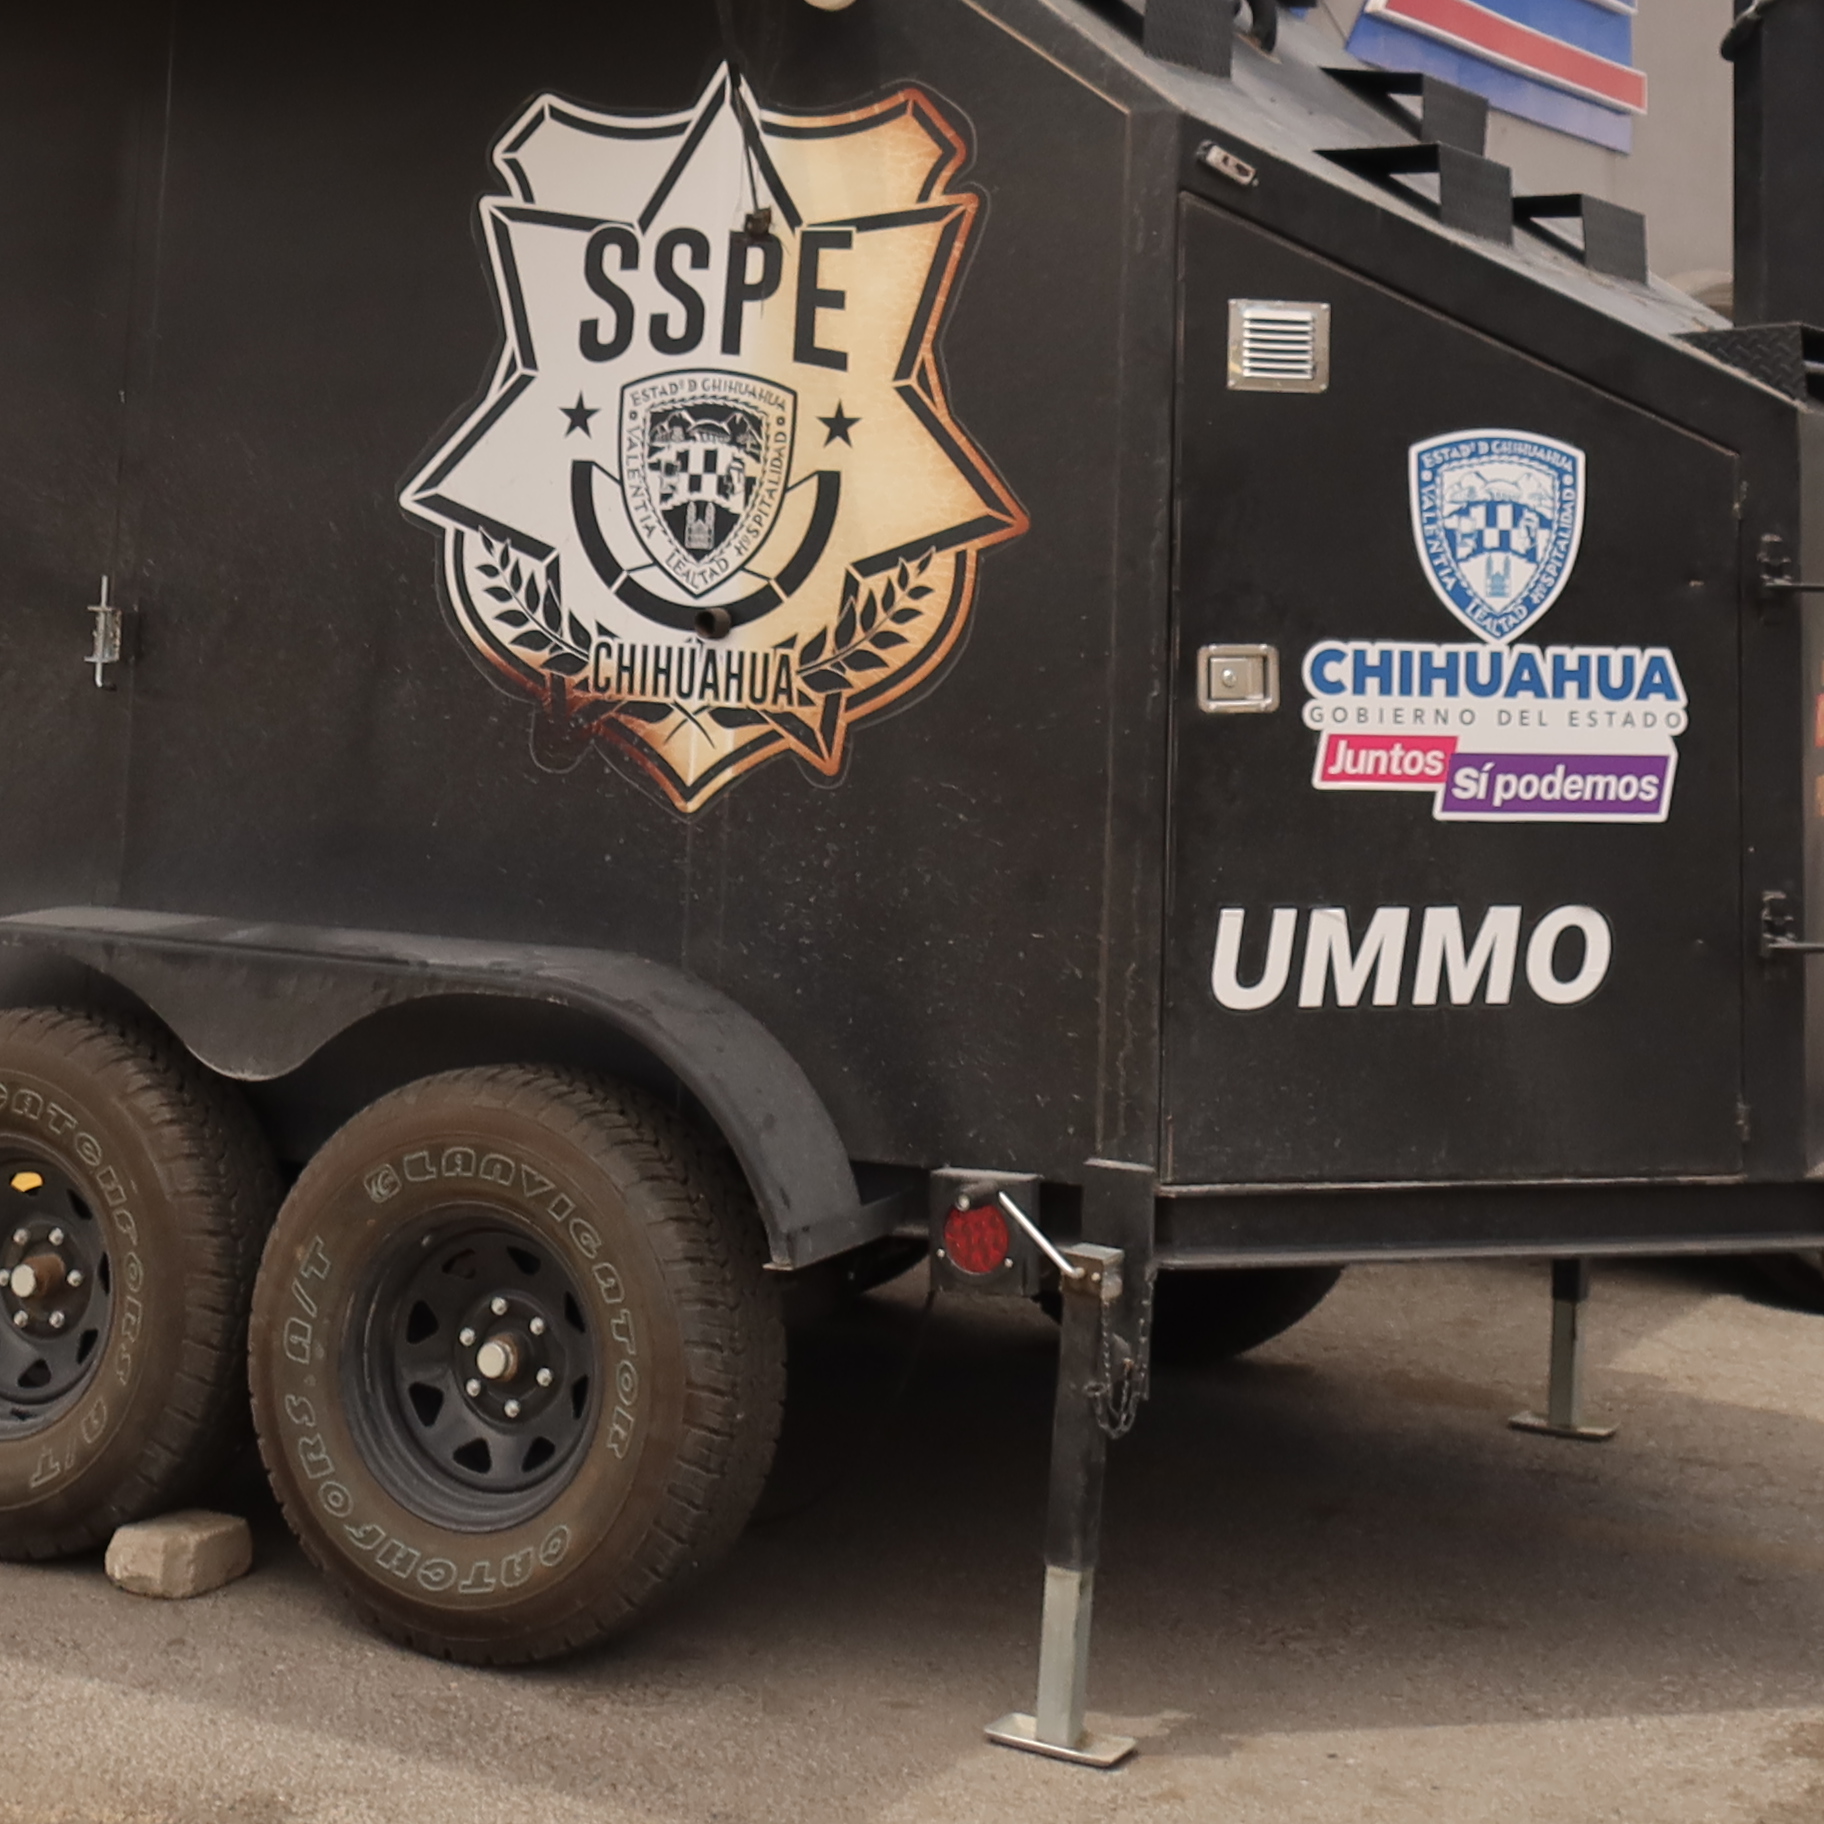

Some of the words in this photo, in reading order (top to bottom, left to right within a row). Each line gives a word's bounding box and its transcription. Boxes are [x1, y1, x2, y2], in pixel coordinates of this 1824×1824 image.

[579, 226, 854, 372] SSPE
[701, 377, 787, 413] CHIHUAHUA
[664, 550, 731, 591] LEALTAD
[1465, 600, 1528, 637] LEALTAD
[593, 641, 796, 707] CHIHUAHUA
[1311, 648, 1679, 702] CHIHUAHUA
[1309, 705, 1476, 726] GOBIERNO
[1497, 709, 1549, 728] DEL
[1568, 710, 1683, 730] ESTADO
[1327, 739, 1446, 777] Juntos
[1451, 762, 1496, 801] Sí
[1492, 763, 1660, 809] podemos
[1211, 905, 1613, 1011] UMMO
